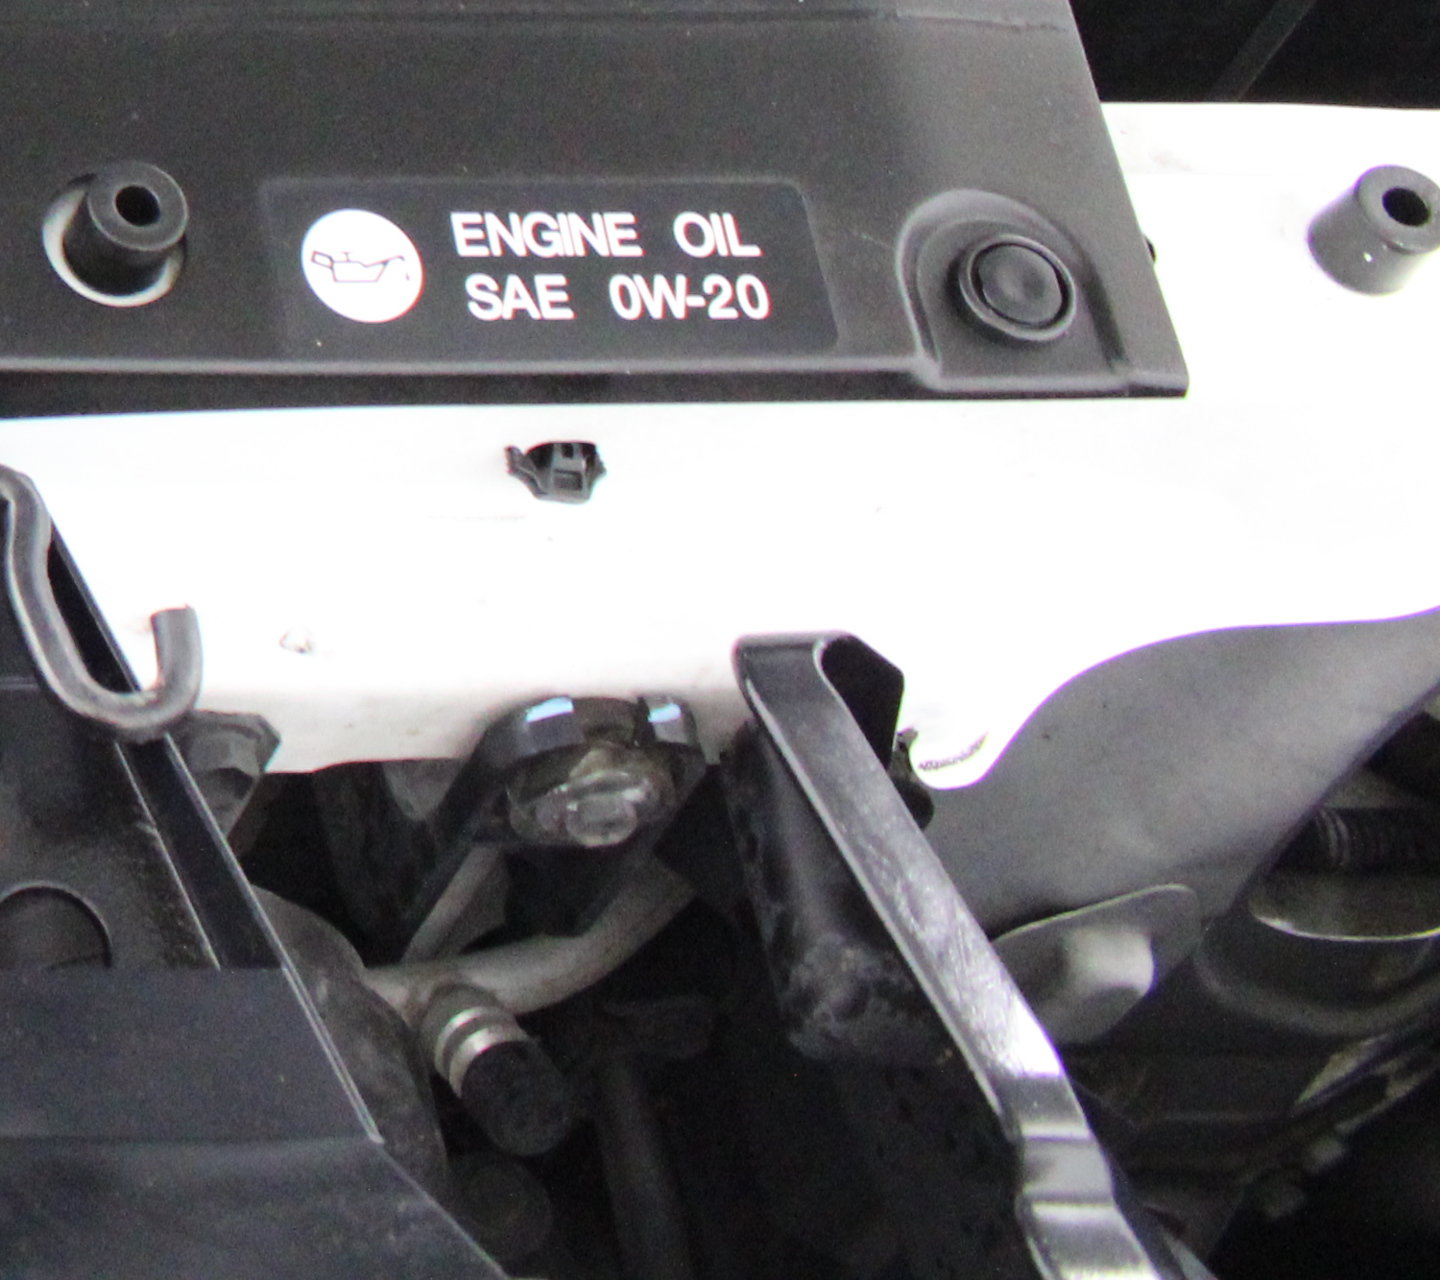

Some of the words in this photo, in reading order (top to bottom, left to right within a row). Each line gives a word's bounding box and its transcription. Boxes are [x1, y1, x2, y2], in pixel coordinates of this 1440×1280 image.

[450, 210, 644, 258] ENGINE
[673, 211, 762, 258] OIL
[464, 273, 575, 321] SAE
[608, 274, 771, 322] 0W-20
